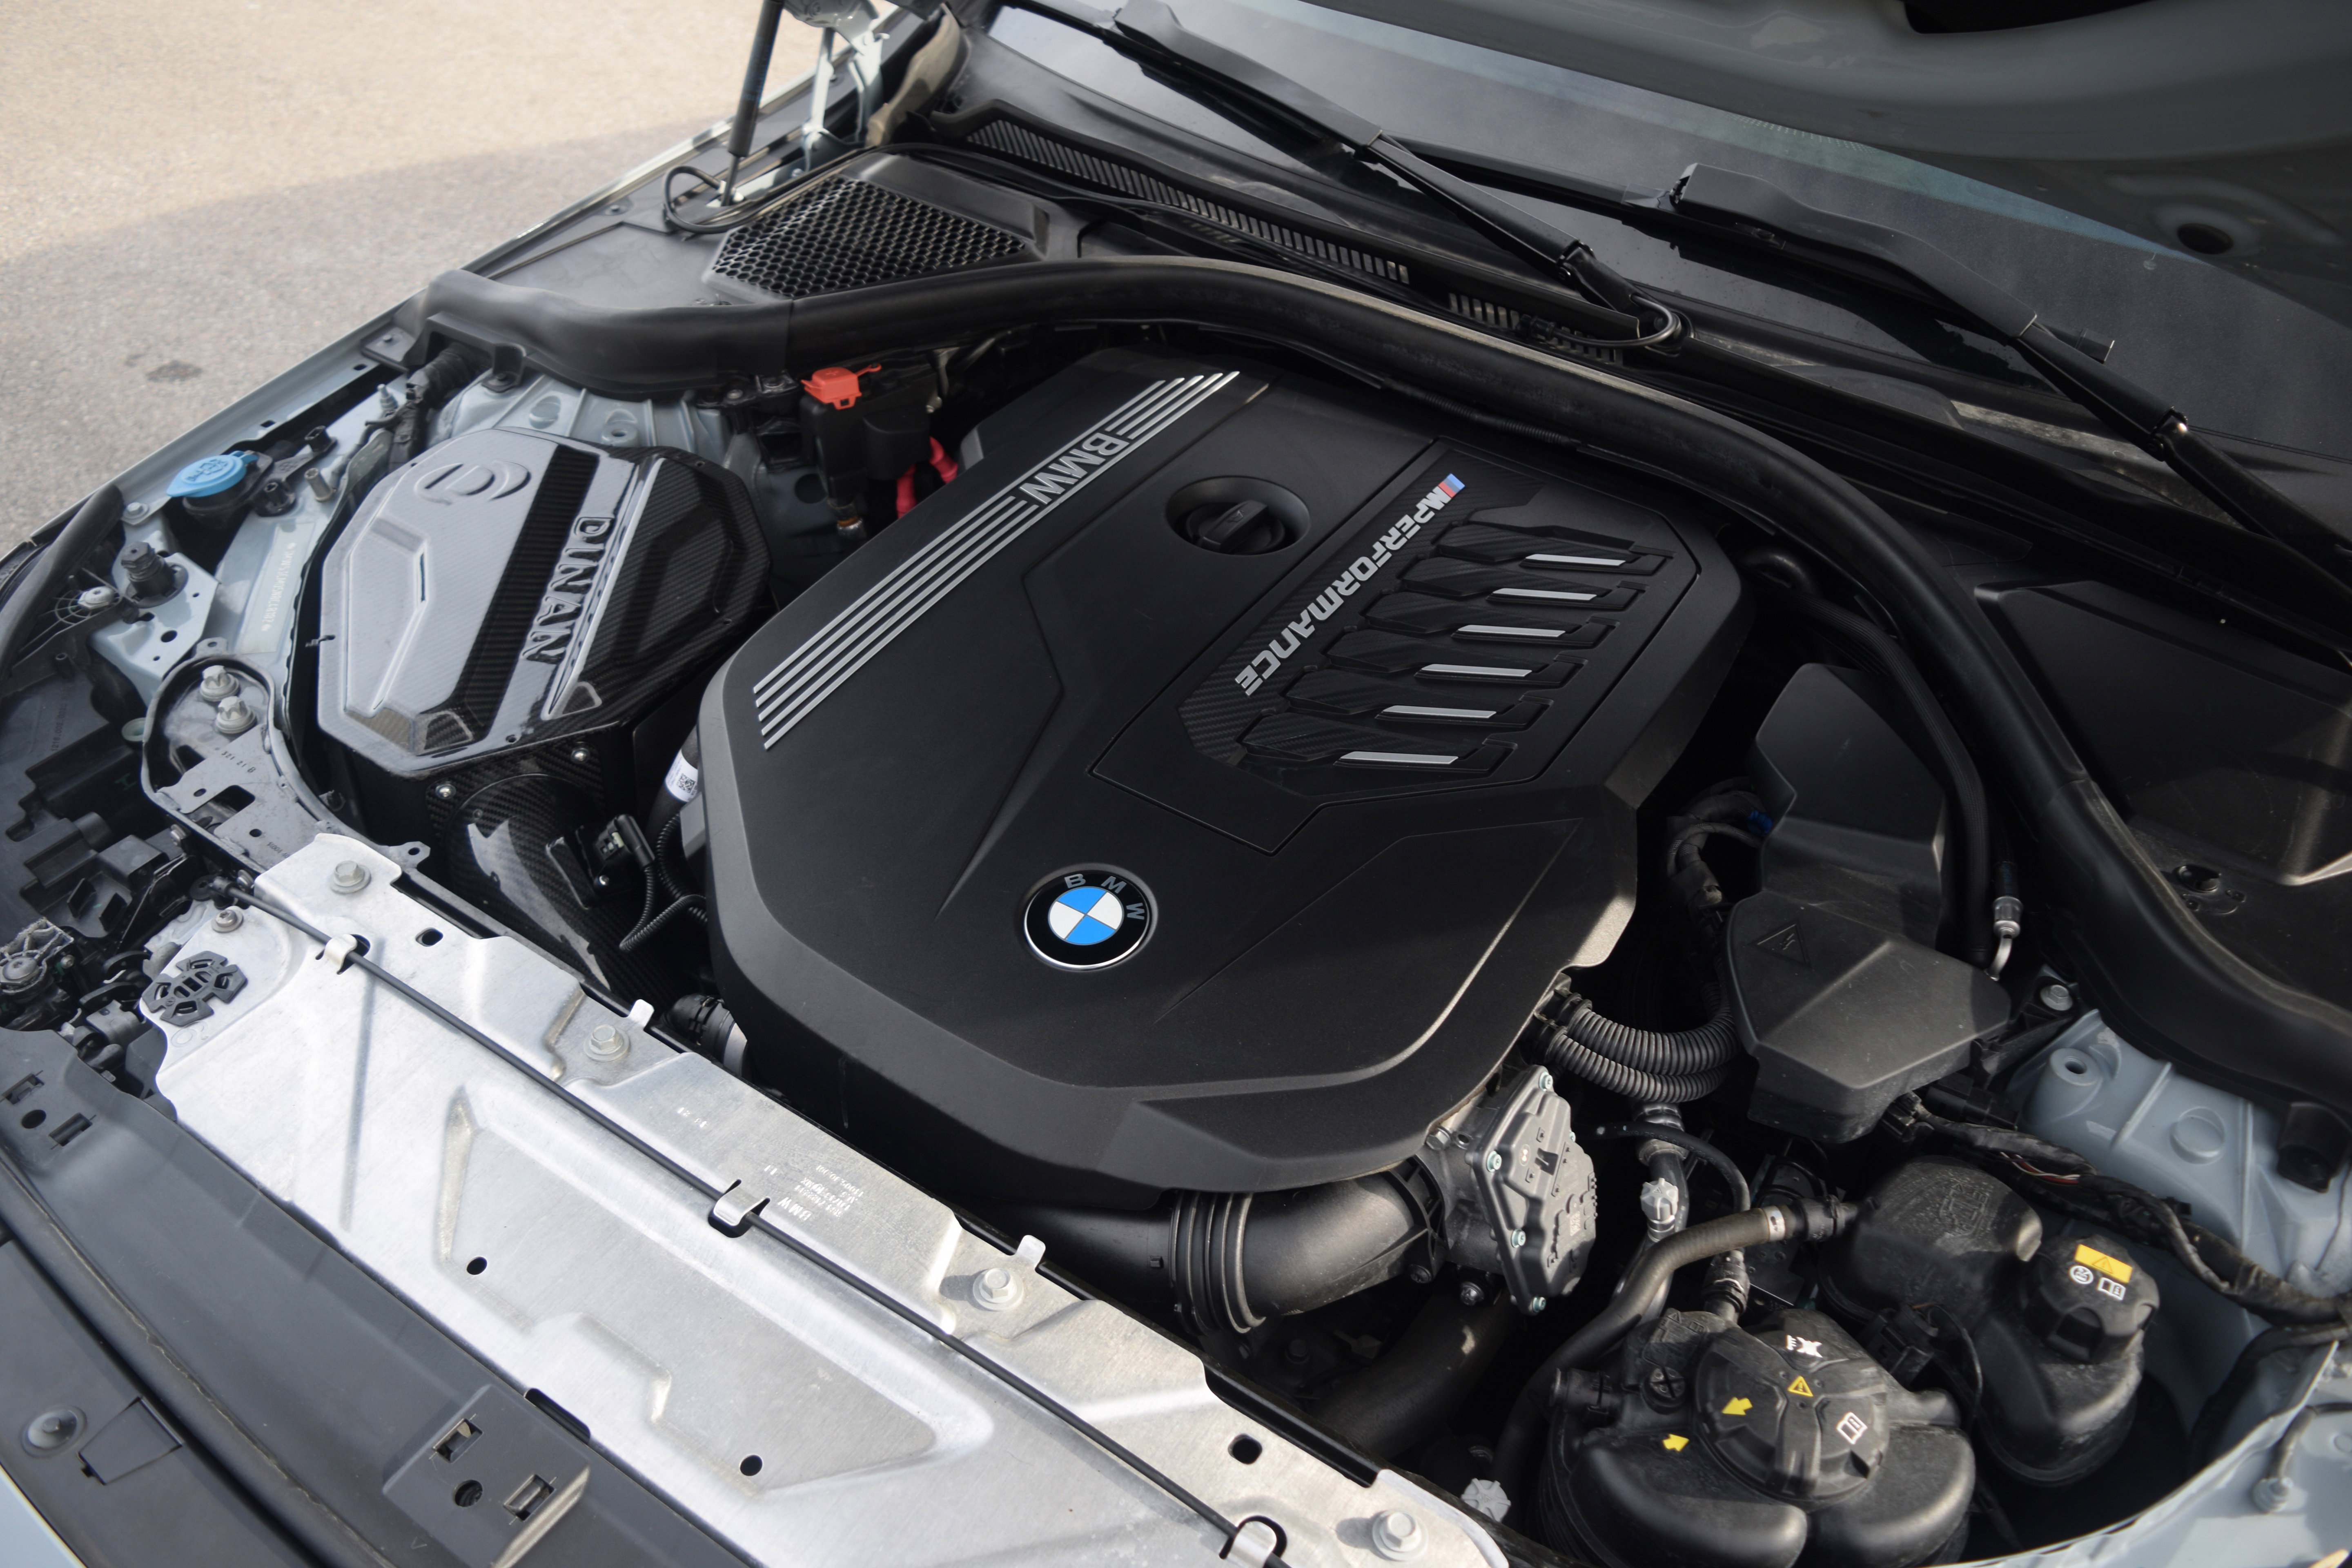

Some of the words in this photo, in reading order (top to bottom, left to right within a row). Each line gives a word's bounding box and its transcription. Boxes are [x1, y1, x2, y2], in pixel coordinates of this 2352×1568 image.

[1020, 432, 1130, 506] BMW
[523, 516, 615, 663] DINAN
[1234, 502, 1435, 696] PERFORMANCE
[1064, 873, 1145, 920] BMW
[777, 1196, 813, 1221] BMW
